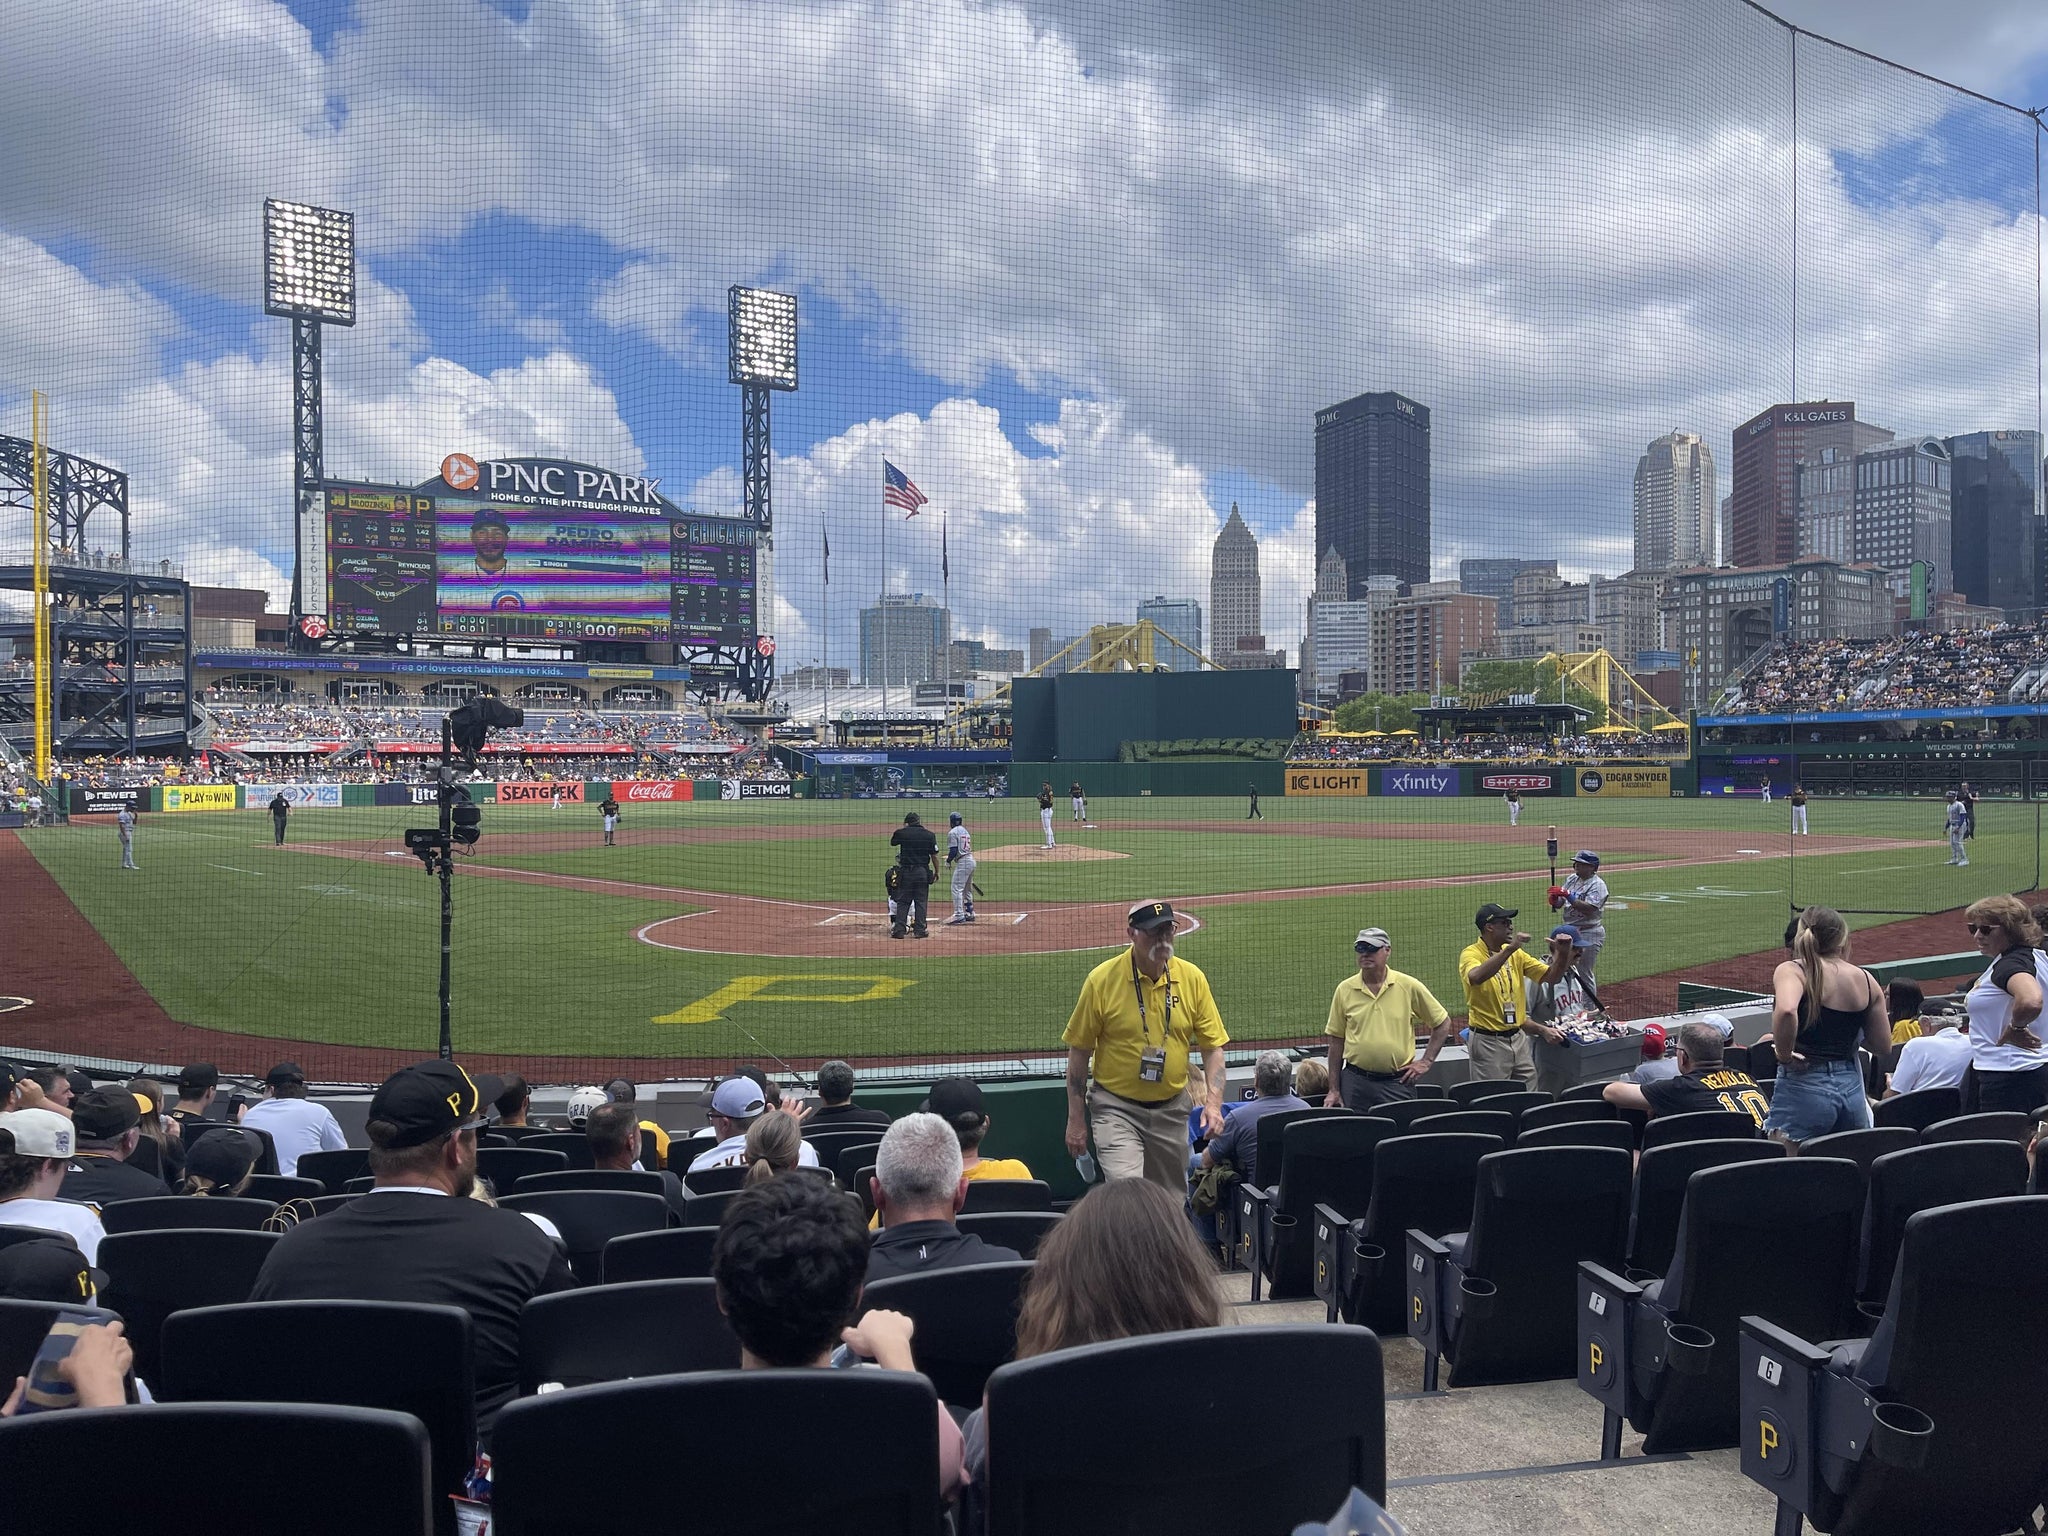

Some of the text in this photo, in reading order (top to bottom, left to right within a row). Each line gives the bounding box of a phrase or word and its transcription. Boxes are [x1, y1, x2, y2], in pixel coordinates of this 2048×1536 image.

[1396, 400, 1416, 417] UPMC
[1315, 410, 1340, 427] UPMC
[1784, 411, 1847, 422] K&L GATES
[486, 461, 663, 505] PNC PARK
[490, 492, 661, 516] HOME OF THE PITTSBURGH PIRATES
[555, 526, 614, 541] PEDRO
[689, 522, 755, 547] CHICAGO
[398, 562, 431, 570] REYNOLDS
[543, 560, 568, 568] SINGLE
[267, 660, 316, 669] prepared
[318, 661, 340, 669] with
[391, 662, 564, 676] Free or low-cost healthcare for kids.
[1441, 696, 1461, 707] IT'S
[1507, 693, 1536, 706] TIME
[857, 712, 933, 721] FAT HEAD'S
[1926, 743, 1962, 751] WELCOME
[1291, 775, 1361, 790] IC LIGHT
[1392, 773, 1448, 792] xfinity
[1487, 778, 1547, 787] SHEETZ
[1605, 773, 1668, 782] EDGAR SNYDER
[316, 786, 338, 801] 125
[411, 787, 438, 804] Lite
[502, 784, 579, 801] SEATGEK
[628, 783, 677, 799] Coca-Cola
[742, 784, 791, 795] BETMGM
[184, 792, 205, 804] PLAY
[214, 792, 233, 802] WIN!
[1153, 903, 1163, 916] P
[651, 975, 920, 1024] P
[1171, 995, 1180, 1009] P
[446, 1092, 461, 1118] P
[1318, 1260, 1326, 1284] P
[1413, 1295, 1423, 1323] P
[1589, 1342, 1603, 1375] P
[1765, 1360, 1774, 1381] G
[1760, 1420, 1779, 1460] P
